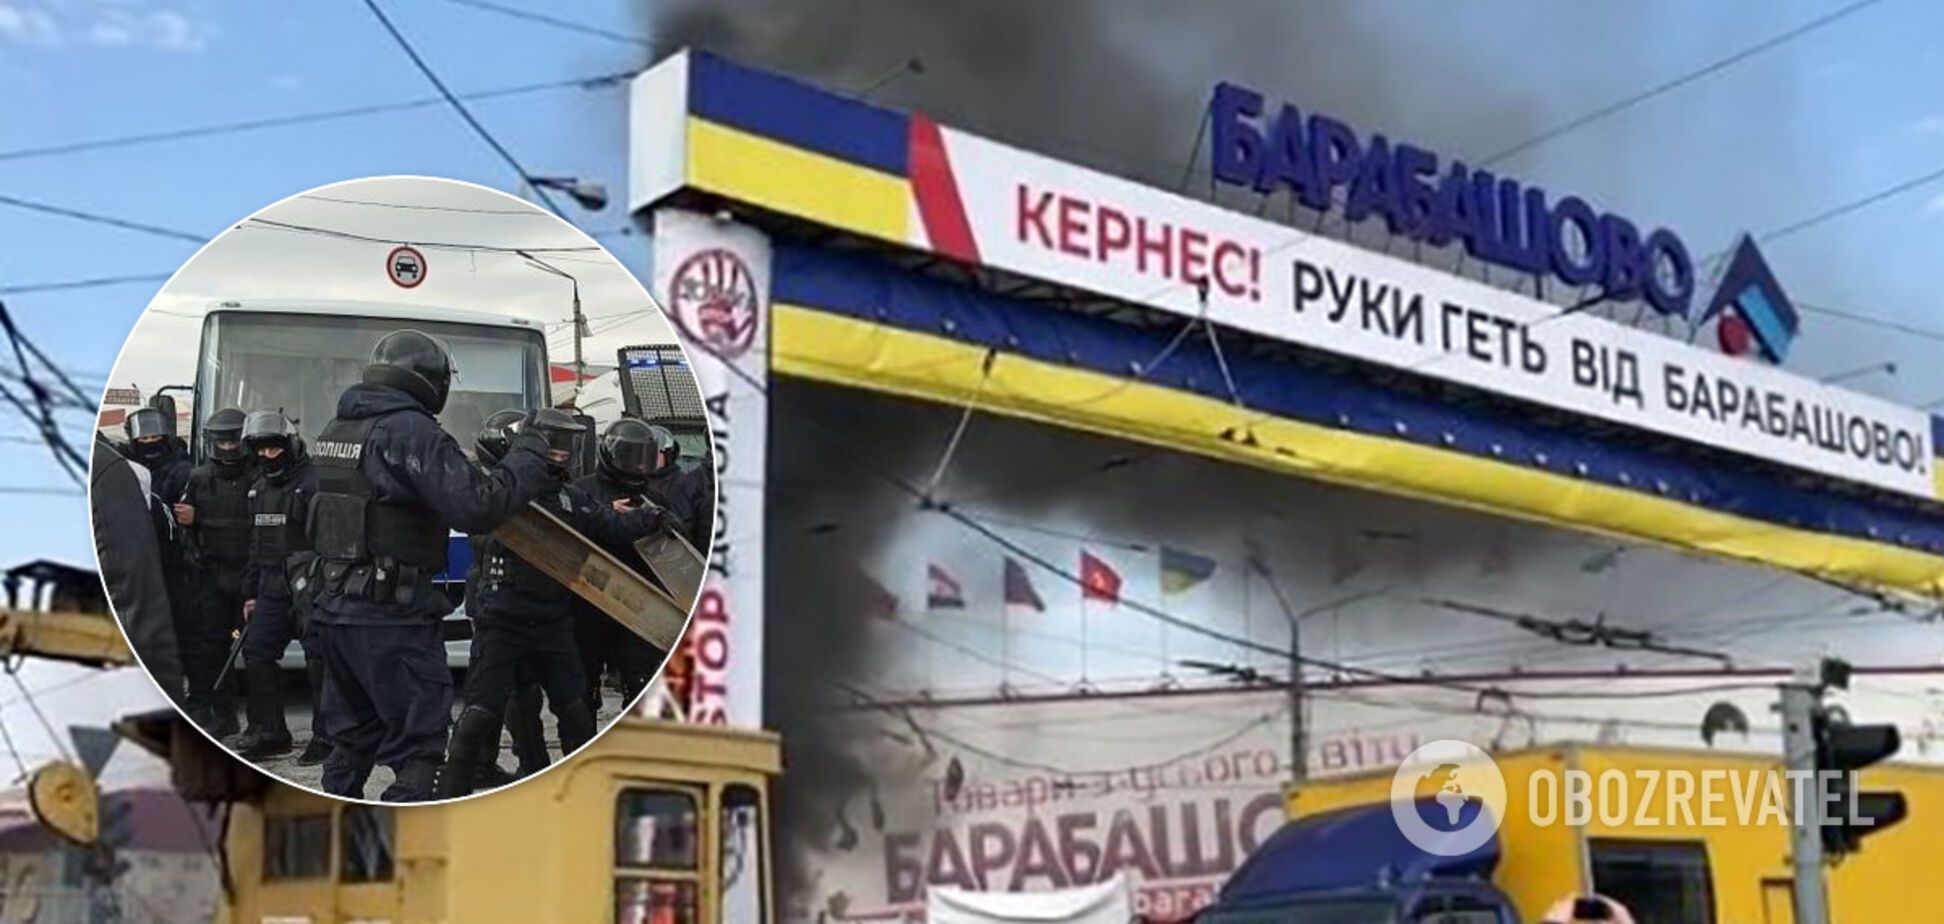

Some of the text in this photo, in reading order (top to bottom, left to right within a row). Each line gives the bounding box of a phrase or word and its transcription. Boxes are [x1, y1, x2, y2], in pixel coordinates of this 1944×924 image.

[1017, 184, 1926, 475] КЕРНЕС! РУКИ ГЕТЬ ВІД БАРАБАШОВО!
[1213, 81, 1694, 319] БАРАБАШОВО
